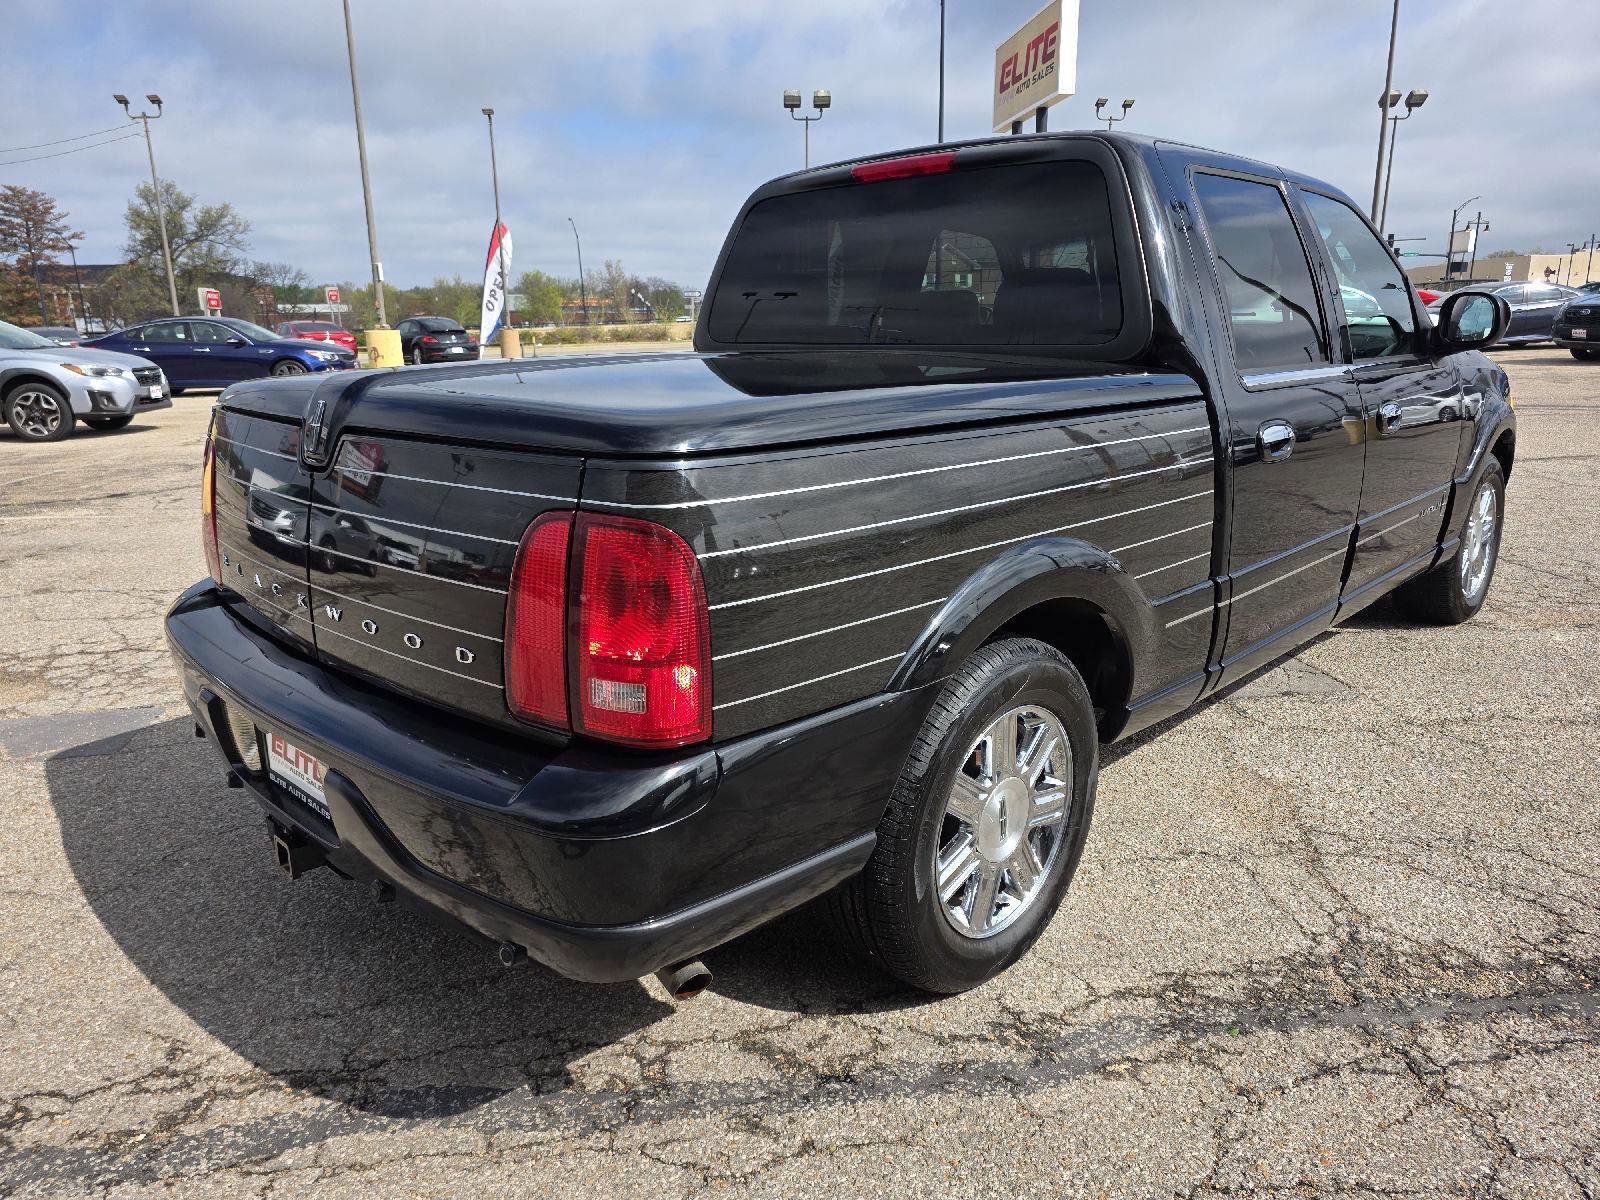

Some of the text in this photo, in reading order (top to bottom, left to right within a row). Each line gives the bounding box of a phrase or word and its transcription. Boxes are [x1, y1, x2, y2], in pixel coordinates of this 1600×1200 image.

[999, 21, 1059, 94] ELITE
[1015, 62, 1055, 96] AUTO SALES
[223, 553, 475, 664] BLACKWOOD
[269, 773, 331, 819] ELITE AUTO SALES
[289, 766, 305, 781] AUTO
